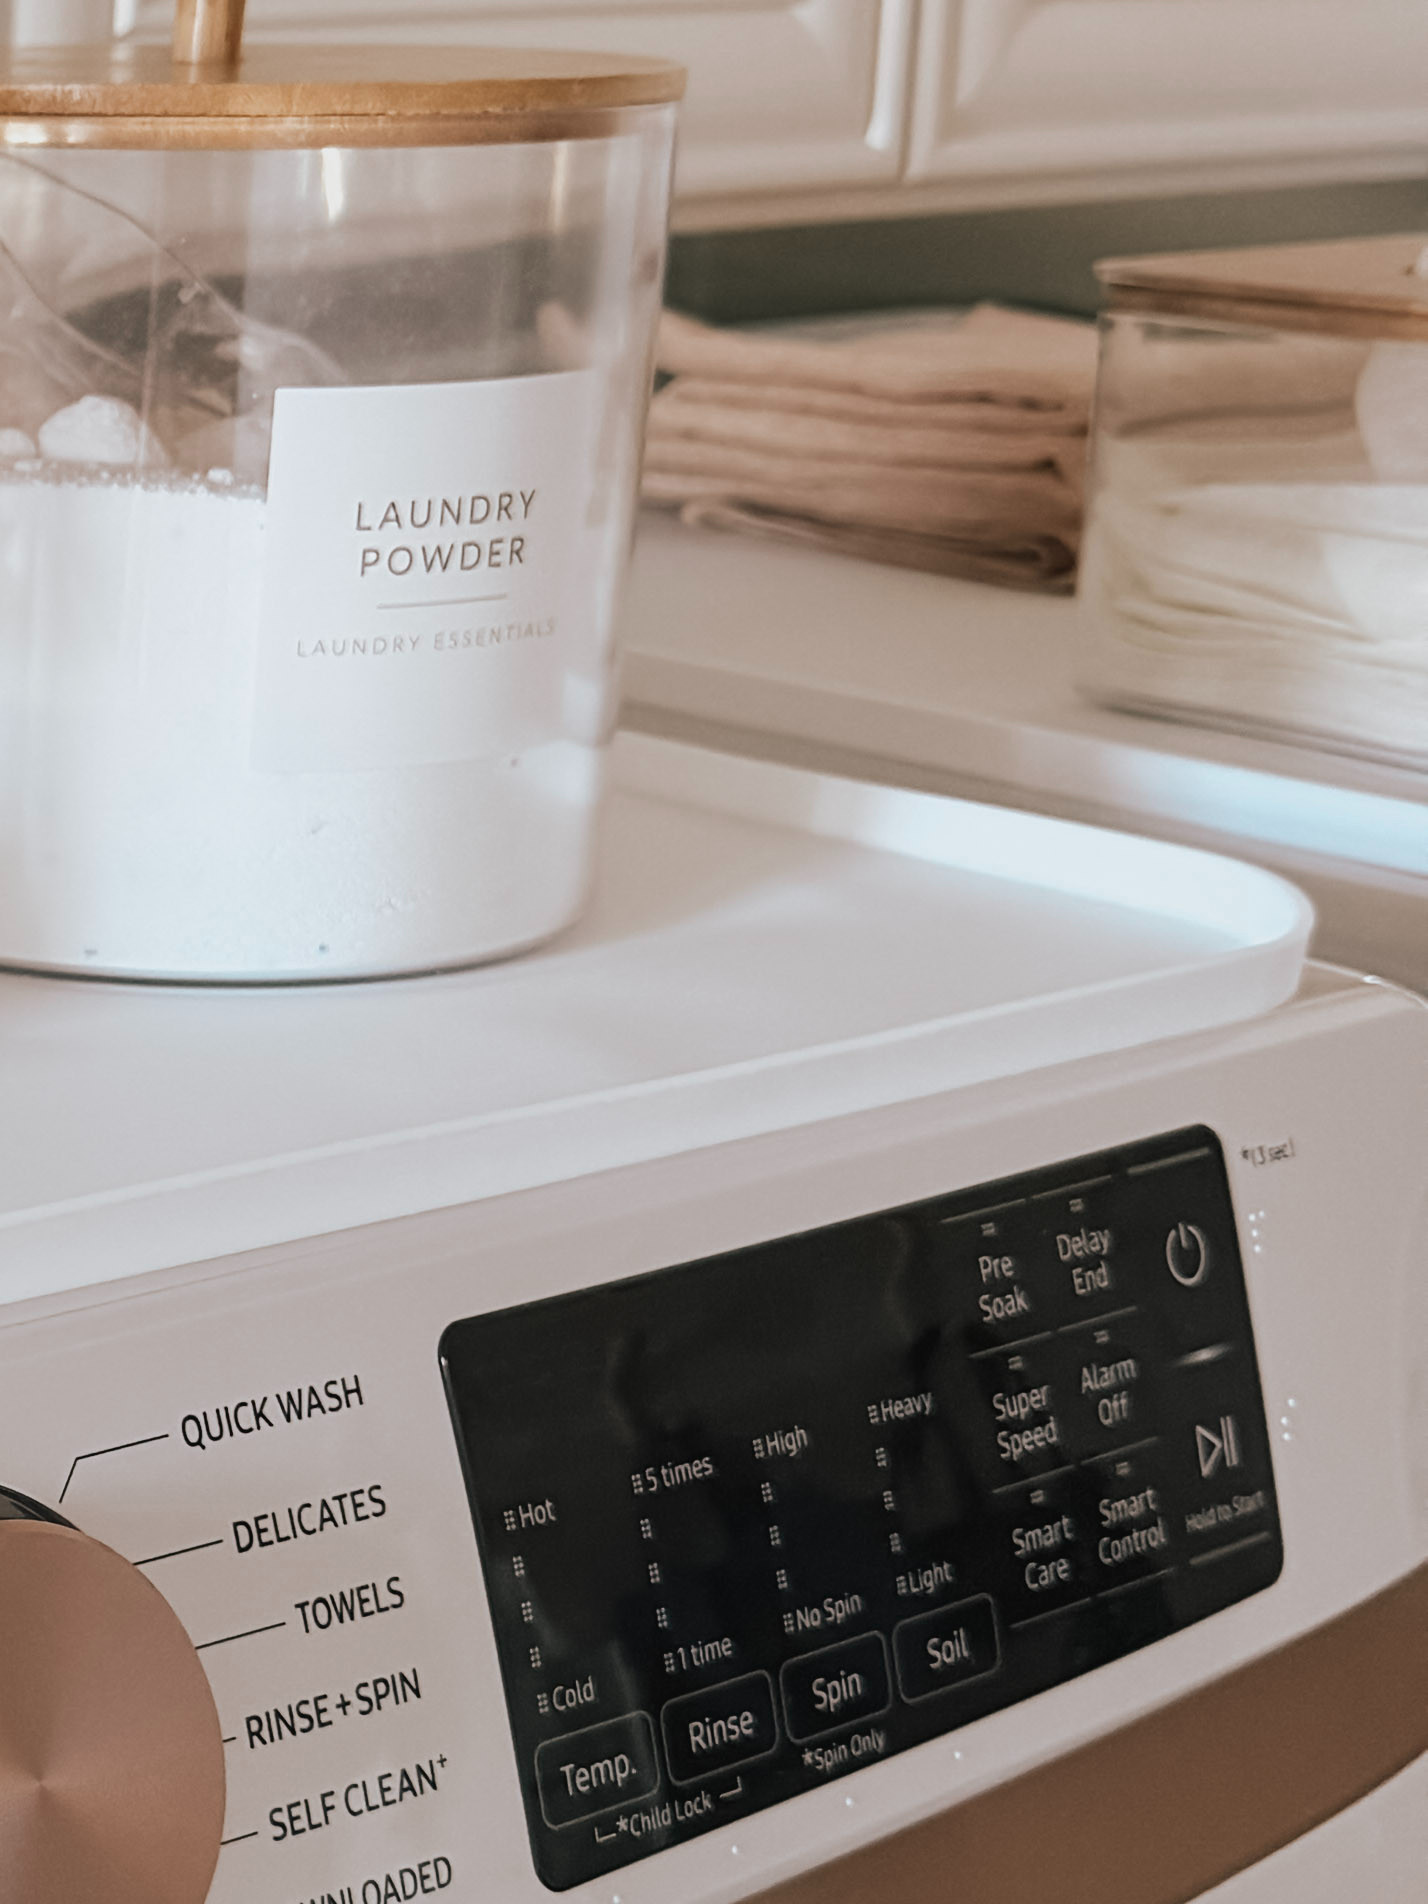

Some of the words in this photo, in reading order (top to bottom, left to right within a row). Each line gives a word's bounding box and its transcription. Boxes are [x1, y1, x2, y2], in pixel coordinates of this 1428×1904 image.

[354, 488, 536, 532] LAUNDRY
[359, 535, 526, 578] POWDER
[296, 634, 421, 658] LAUNDRY
[433, 617, 558, 651] ESSENTIALS
[1055, 1227, 1111, 1262] Delay
[978, 1254, 1015, 1284] Pre
[1071, 1260, 1110, 1296] End
[978, 1285, 1029, 1324] Soak
[1081, 1357, 1138, 1394] Alarm
[180, 1396, 274, 1450] QUICK
[275, 1374, 364, 1424] WASH
[880, 1392, 933, 1423] Heavy
[992, 1384, 1051, 1421] Super
[1097, 1390, 1130, 1428] Off
[765, 1425, 808, 1457] High
[996, 1416, 1059, 1462] Speed
[645, 1468, 658, 1492] 5
[660, 1456, 715, 1487] times
[232, 1484, 387, 1554] DELICATES
[518, 1499, 557, 1529] Hot
[1098, 1486, 1158, 1529] Smart
[1011, 1514, 1074, 1557] Smart
[1098, 1516, 1167, 1567] Control
[907, 1561, 954, 1595] Light
[1024, 1558, 1072, 1592] Care
[294, 1576, 405, 1634] TOWELS
[795, 1604, 822, 1631] No
[823, 1593, 863, 1625] Spin
[676, 1647, 688, 1670] 1
[690, 1636, 734, 1667] time
[925, 1627, 970, 1671] Soil
[552, 1676, 596, 1712] Cold
[812, 1669, 863, 1712] Spin
[688, 1710, 754, 1754] Rinse
[849, 1729, 888, 1757] Only
[559, 1752, 638, 1797] Temp.
[268, 1790, 336, 1842] SELF
[674, 1790, 713, 1822] Lock
